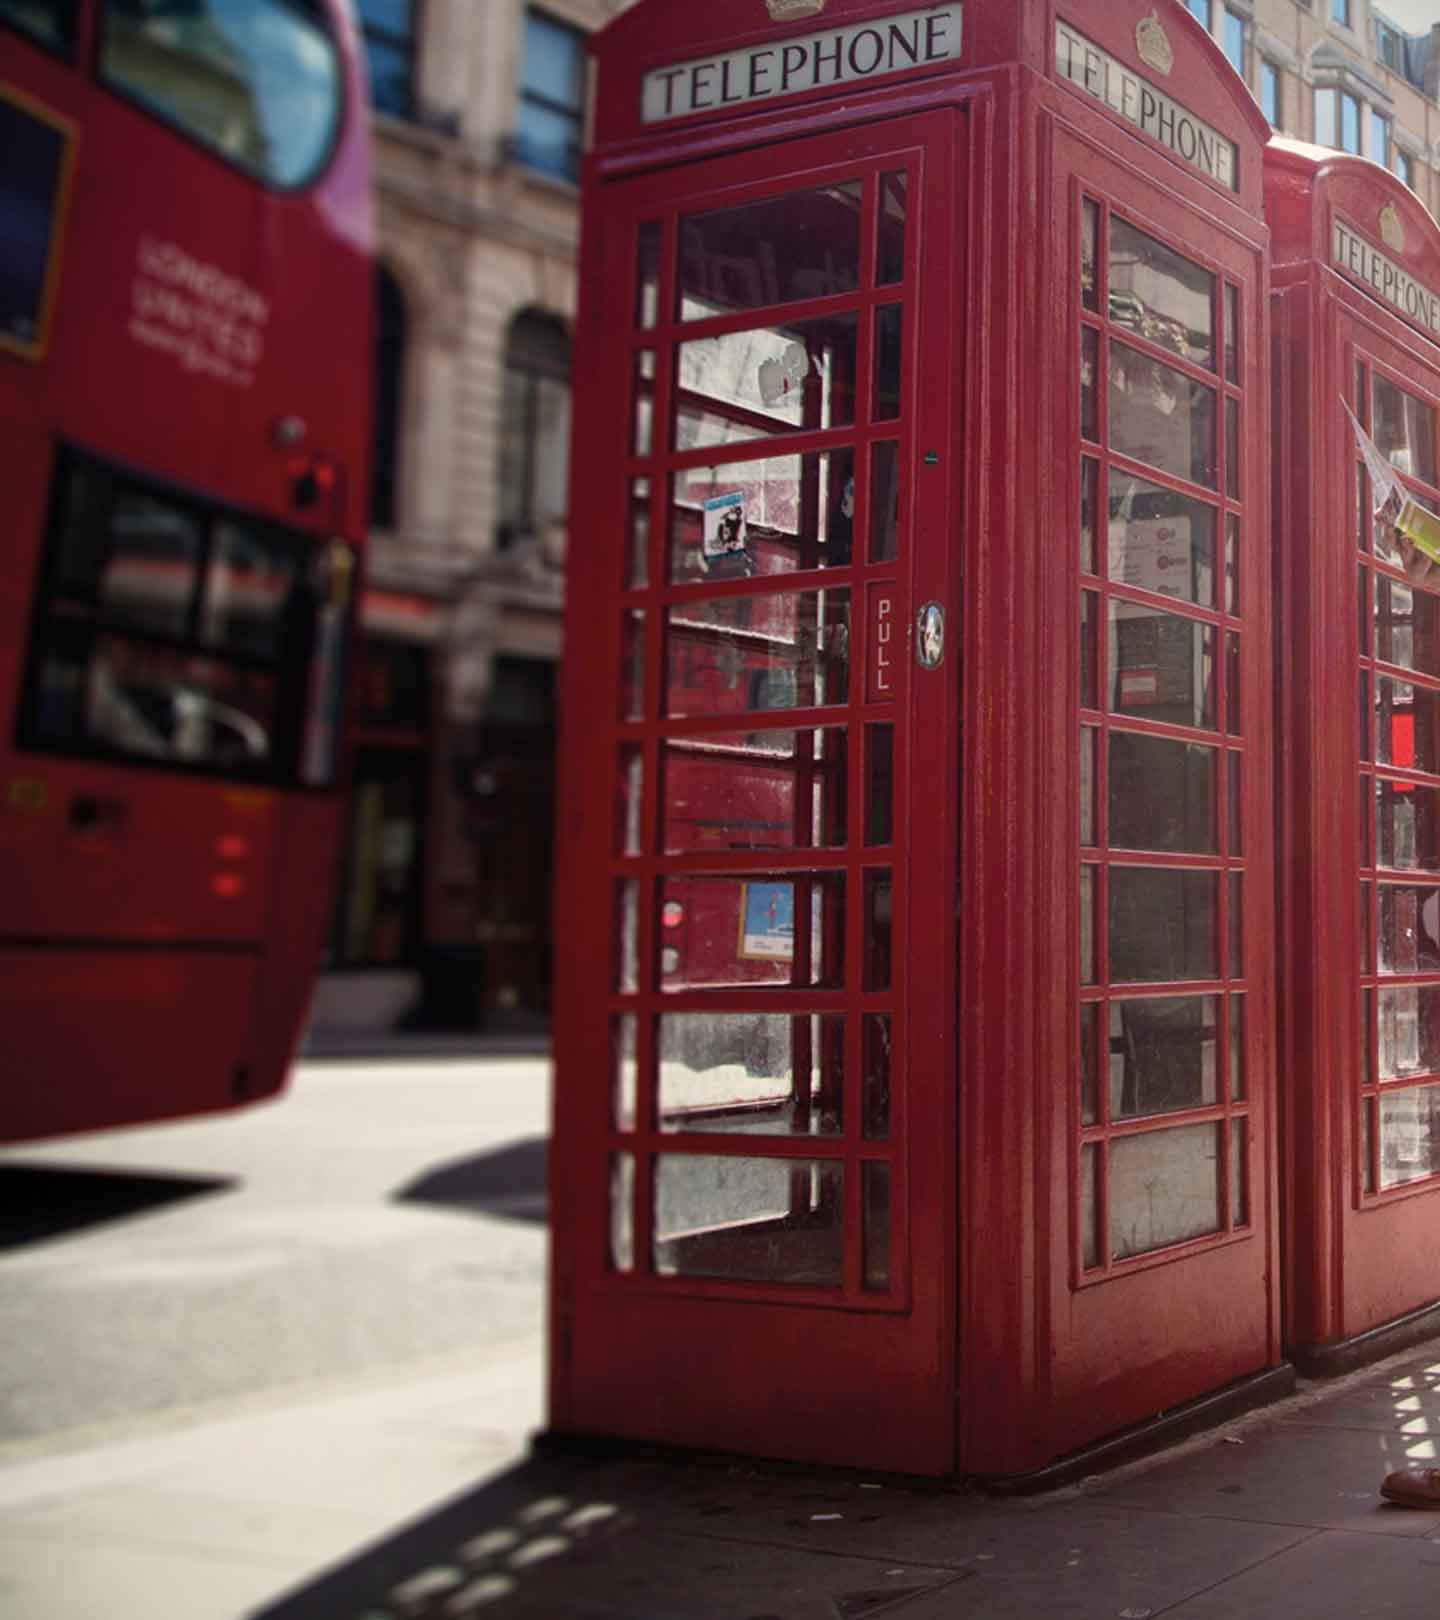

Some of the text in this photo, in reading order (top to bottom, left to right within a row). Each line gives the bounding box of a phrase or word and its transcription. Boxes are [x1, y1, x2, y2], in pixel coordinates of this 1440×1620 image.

[656, 12, 951, 115] TELEPHONE
[1059, 29, 1228, 186] TELEPHONE
[1335, 224, 1438, 333] TELEPHONE
[878, 599, 891, 690] PULL
